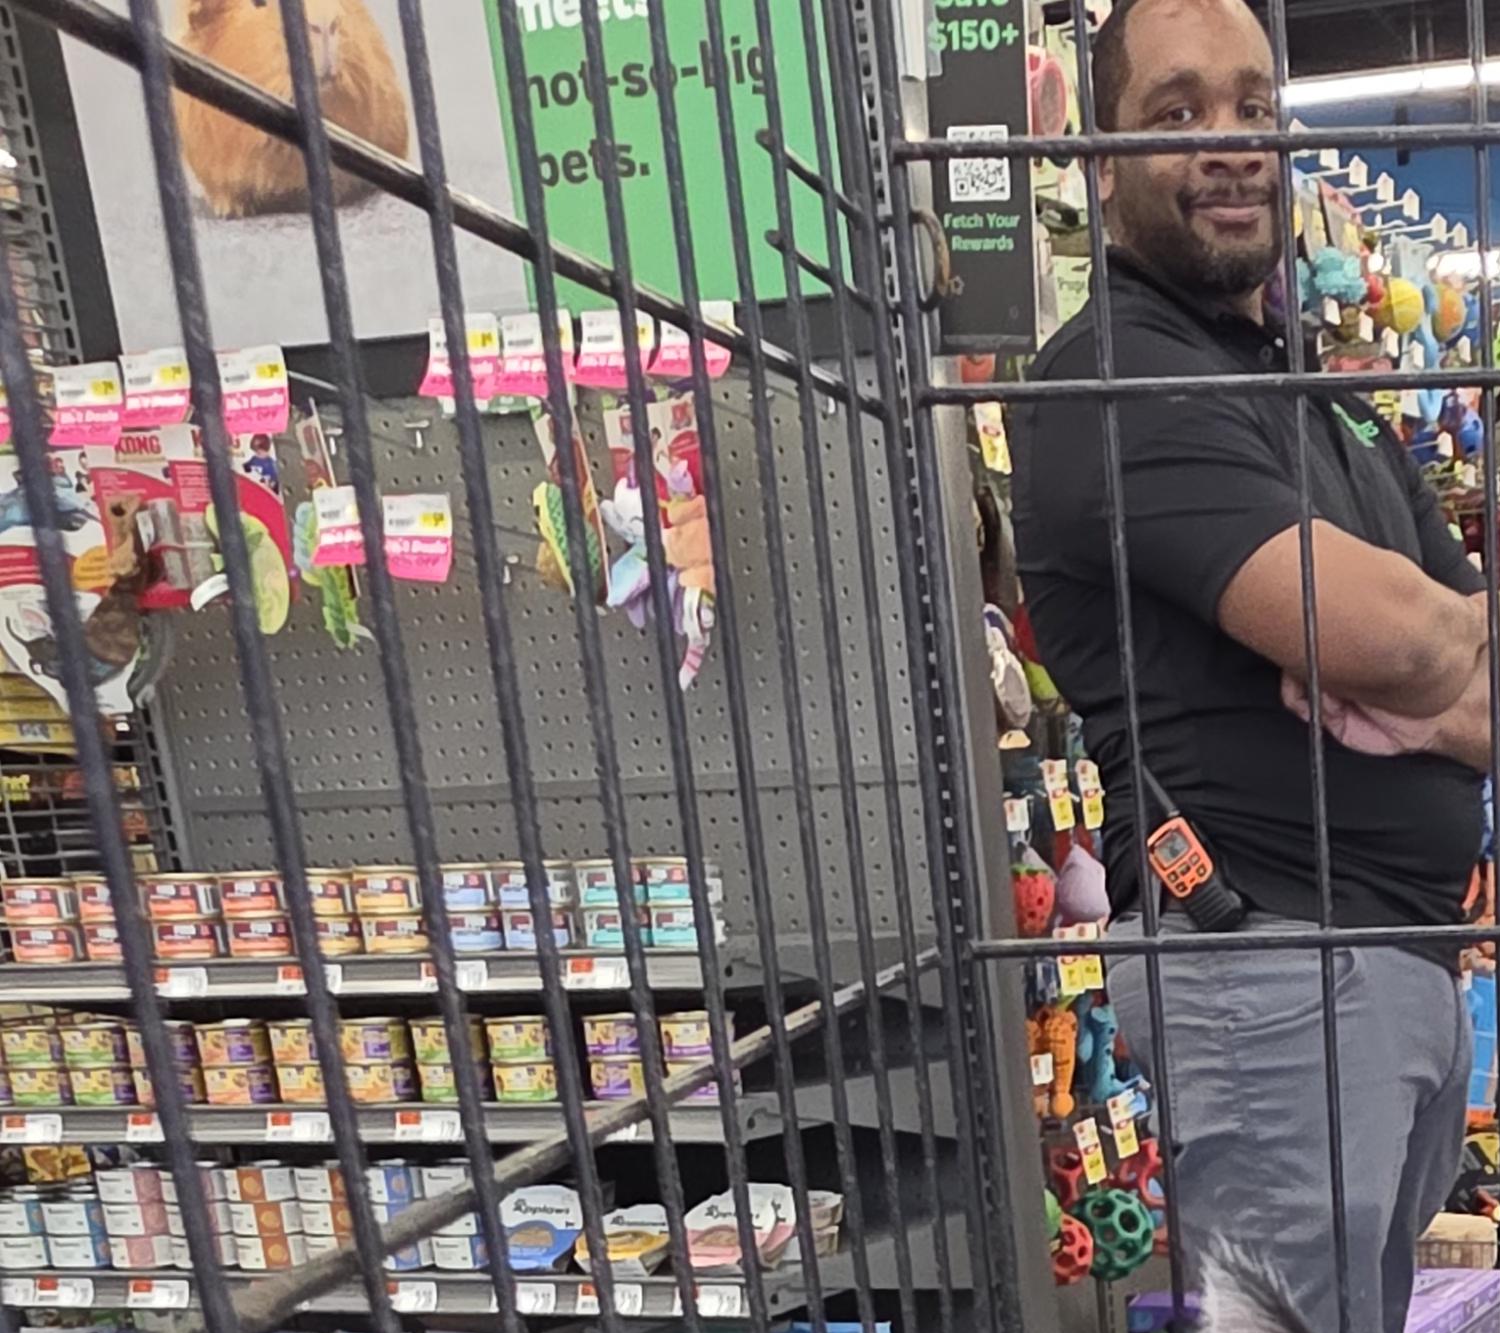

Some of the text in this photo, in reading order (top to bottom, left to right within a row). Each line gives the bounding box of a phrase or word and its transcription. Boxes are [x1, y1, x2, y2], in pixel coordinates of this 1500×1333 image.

[927, 18, 1019, 50] $150+
[943, 212, 1020, 228] Fetch Your
[951, 235, 1015, 251] Rewards
[115, 435, 162, 455] KONG
